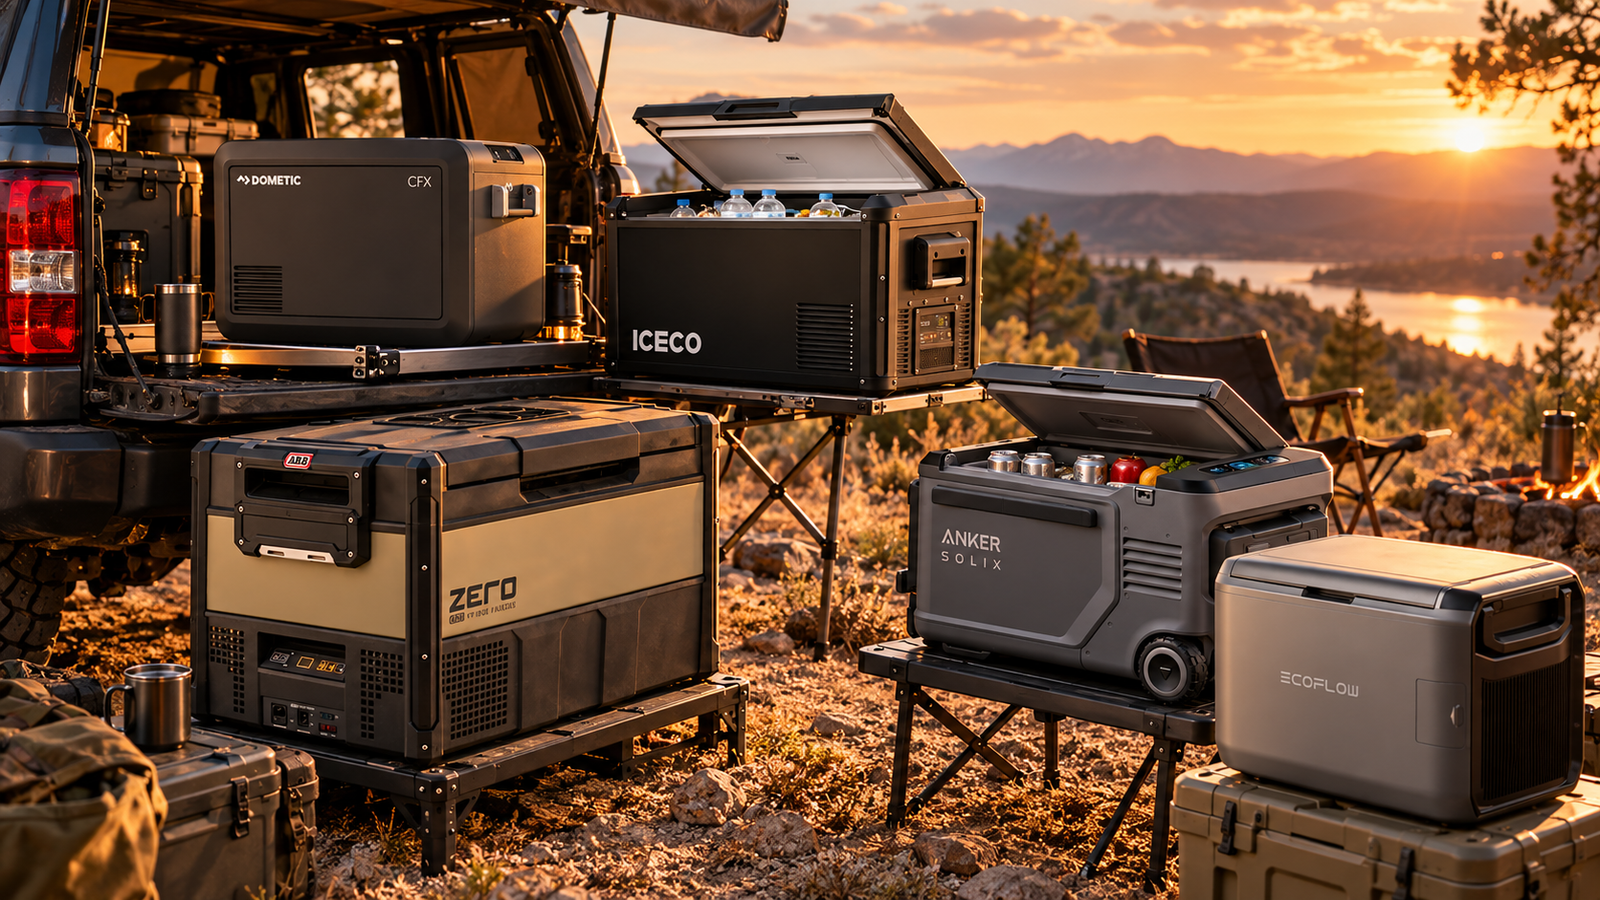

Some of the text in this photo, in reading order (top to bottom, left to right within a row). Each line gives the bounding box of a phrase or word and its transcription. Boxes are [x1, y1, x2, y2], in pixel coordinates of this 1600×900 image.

[251, 175, 301, 186] DOMETIC
[407, 175, 432, 188] CFX
[632, 329, 702, 355] ICECO
[942, 528, 1001, 553] ANKER
[941, 551, 1001, 571] SOLIX
[1280, 670, 1359, 698] ECOFLOW
